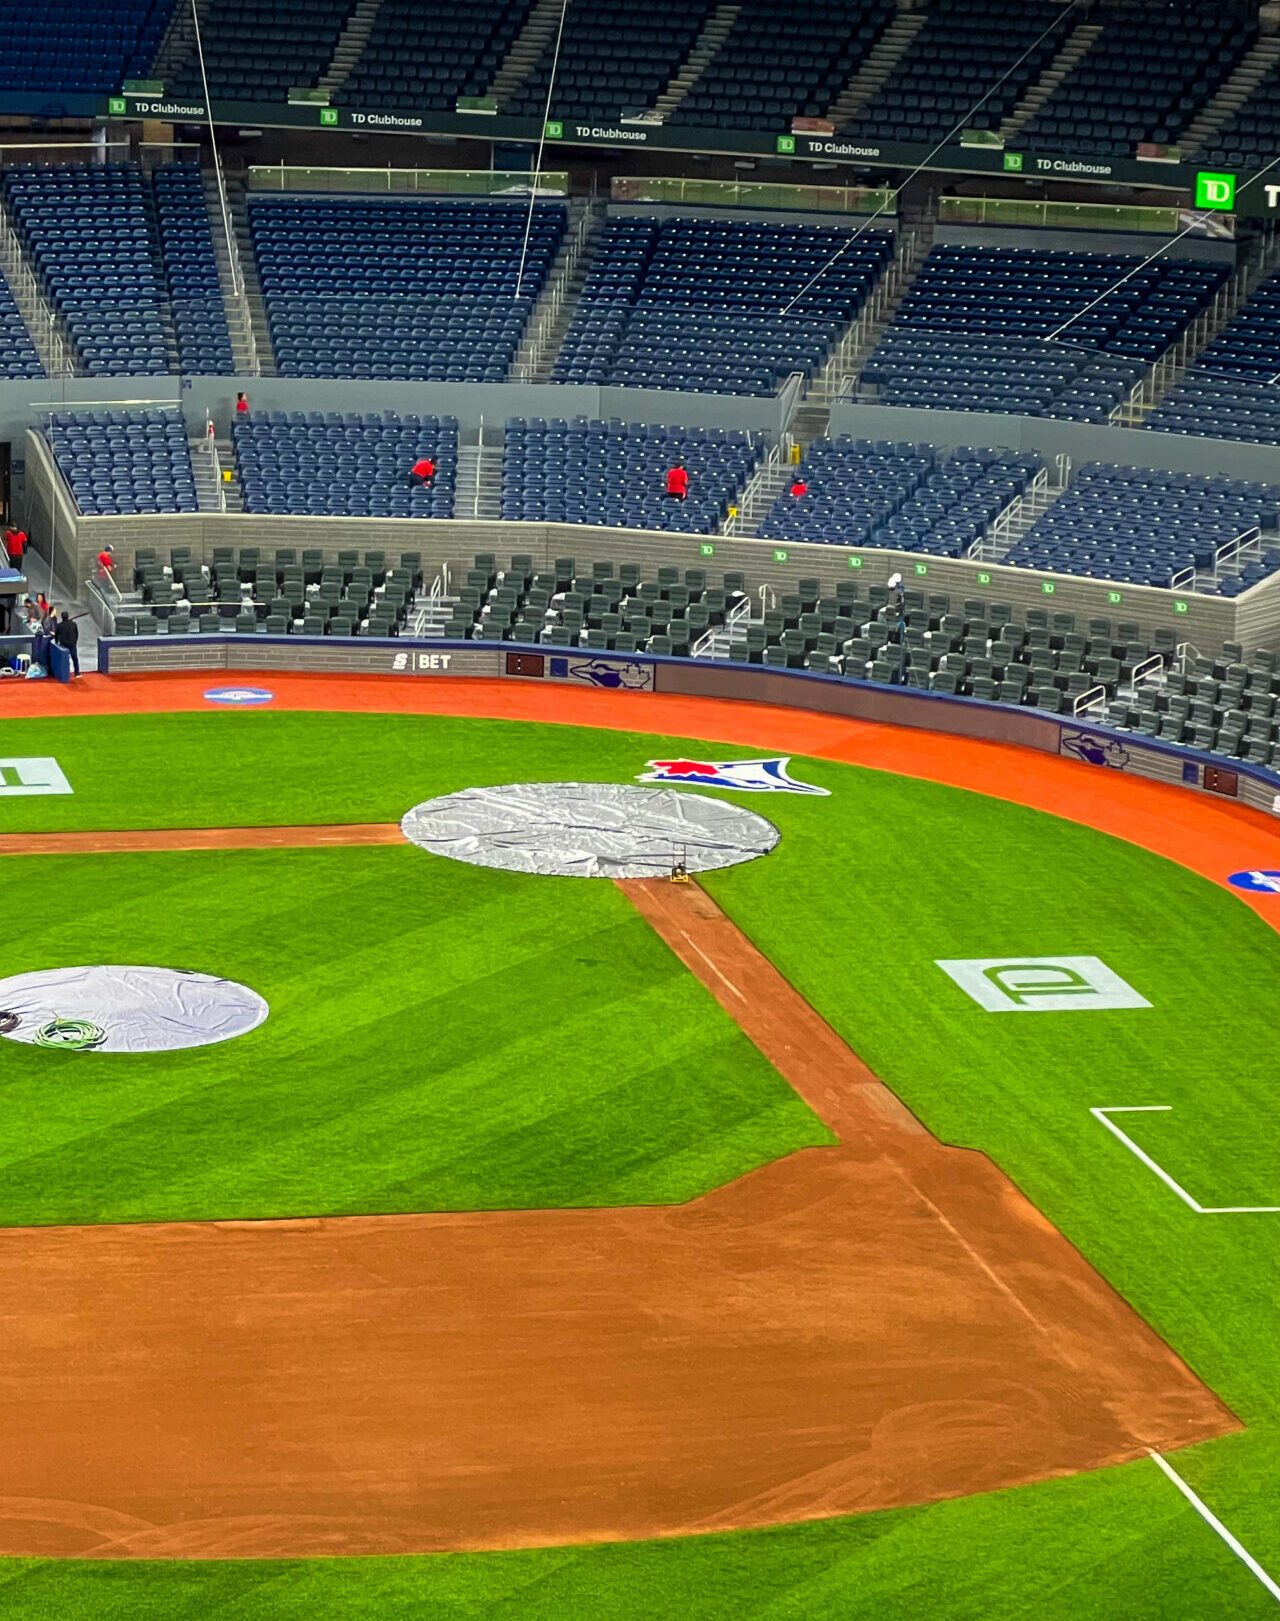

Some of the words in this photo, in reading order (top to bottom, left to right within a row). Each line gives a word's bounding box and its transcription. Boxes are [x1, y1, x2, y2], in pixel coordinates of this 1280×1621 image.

[135, 102, 149, 112] TD
[151, 103, 204, 115] Clubhouse
[351, 113, 365, 123] TD
[367, 115, 422, 126] Clubhouse
[576, 126, 590, 137] TD
[591, 128, 647, 140] Clubhouse
[808, 141, 822, 152] TD
[824, 143, 880, 156] Clubhouse
[1037, 159, 1052, 170] TD
[1053, 160, 1112, 175] Clubhouse
[1202, 180, 1230, 202] TD
[419, 654, 451, 669] BET
[982, 964, 1099, 1005] TD
